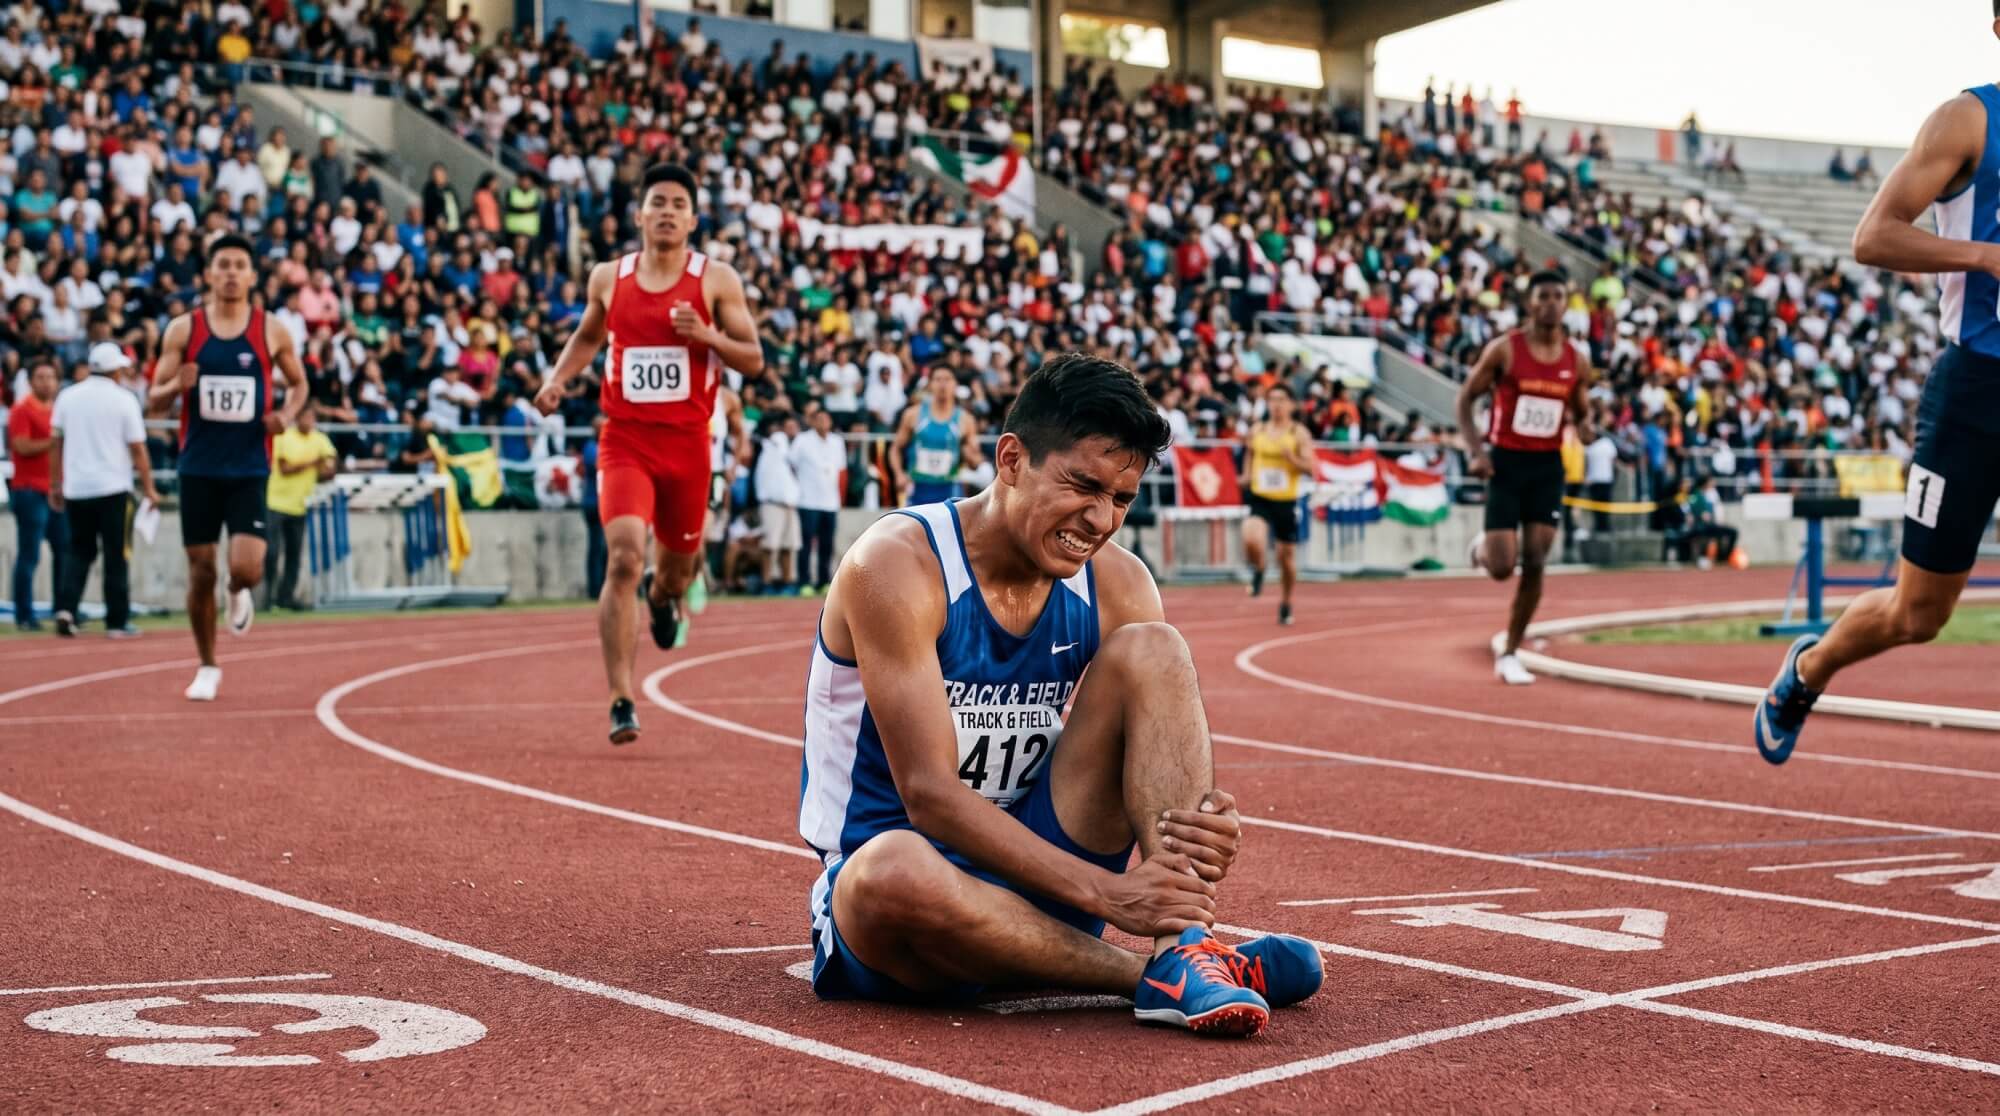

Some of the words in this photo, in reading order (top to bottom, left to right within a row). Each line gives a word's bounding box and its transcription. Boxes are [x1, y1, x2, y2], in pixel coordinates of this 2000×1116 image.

[631, 363, 681, 390] 309
[208, 390, 247, 411] 187
[1918, 476, 1930, 518] 1
[1006, 682, 1020, 705] &
[1026, 681, 1074, 706] FIELD
[959, 711, 1003, 729] TRACK
[1007, 711, 1016, 729] &
[1019, 710, 1052, 729] FIELD
[958, 733, 1049, 790] 412
